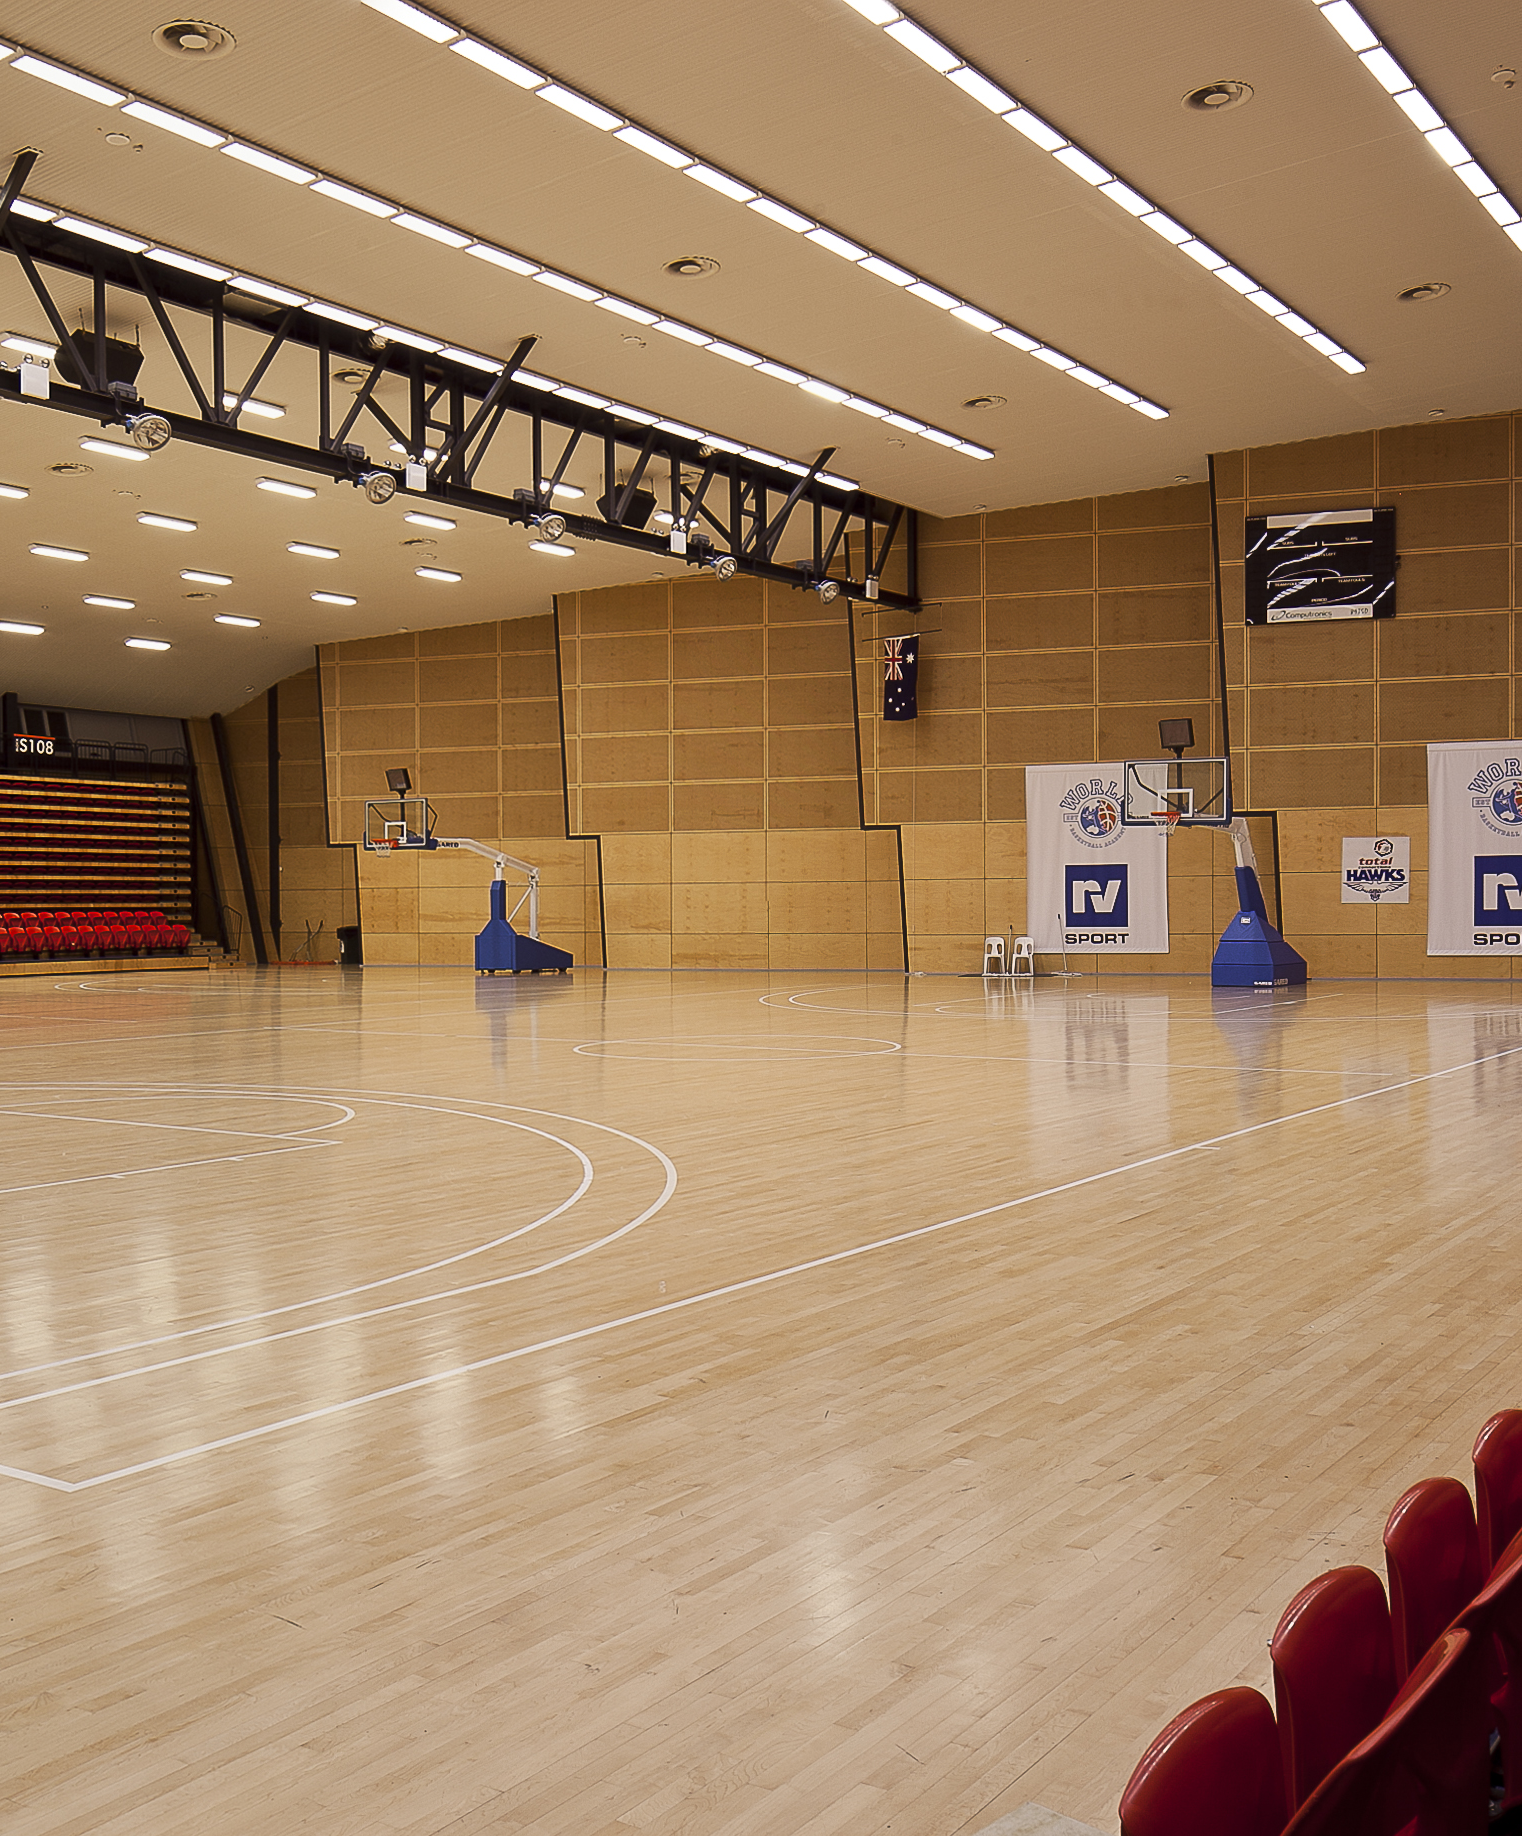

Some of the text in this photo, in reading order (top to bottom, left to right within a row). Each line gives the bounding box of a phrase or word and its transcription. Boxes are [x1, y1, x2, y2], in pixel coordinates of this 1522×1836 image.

[1285, 610, 1333, 620] Computronics
[19, 738, 54, 755] S108
[1480, 813, 1520, 837] BASKETBALL
[1070, 828, 1103, 849] BASKETBALL
[1358, 856, 1394, 866] total
[1346, 868, 1406, 882] HAWKS
[1064, 932, 1130, 945] SPORT
